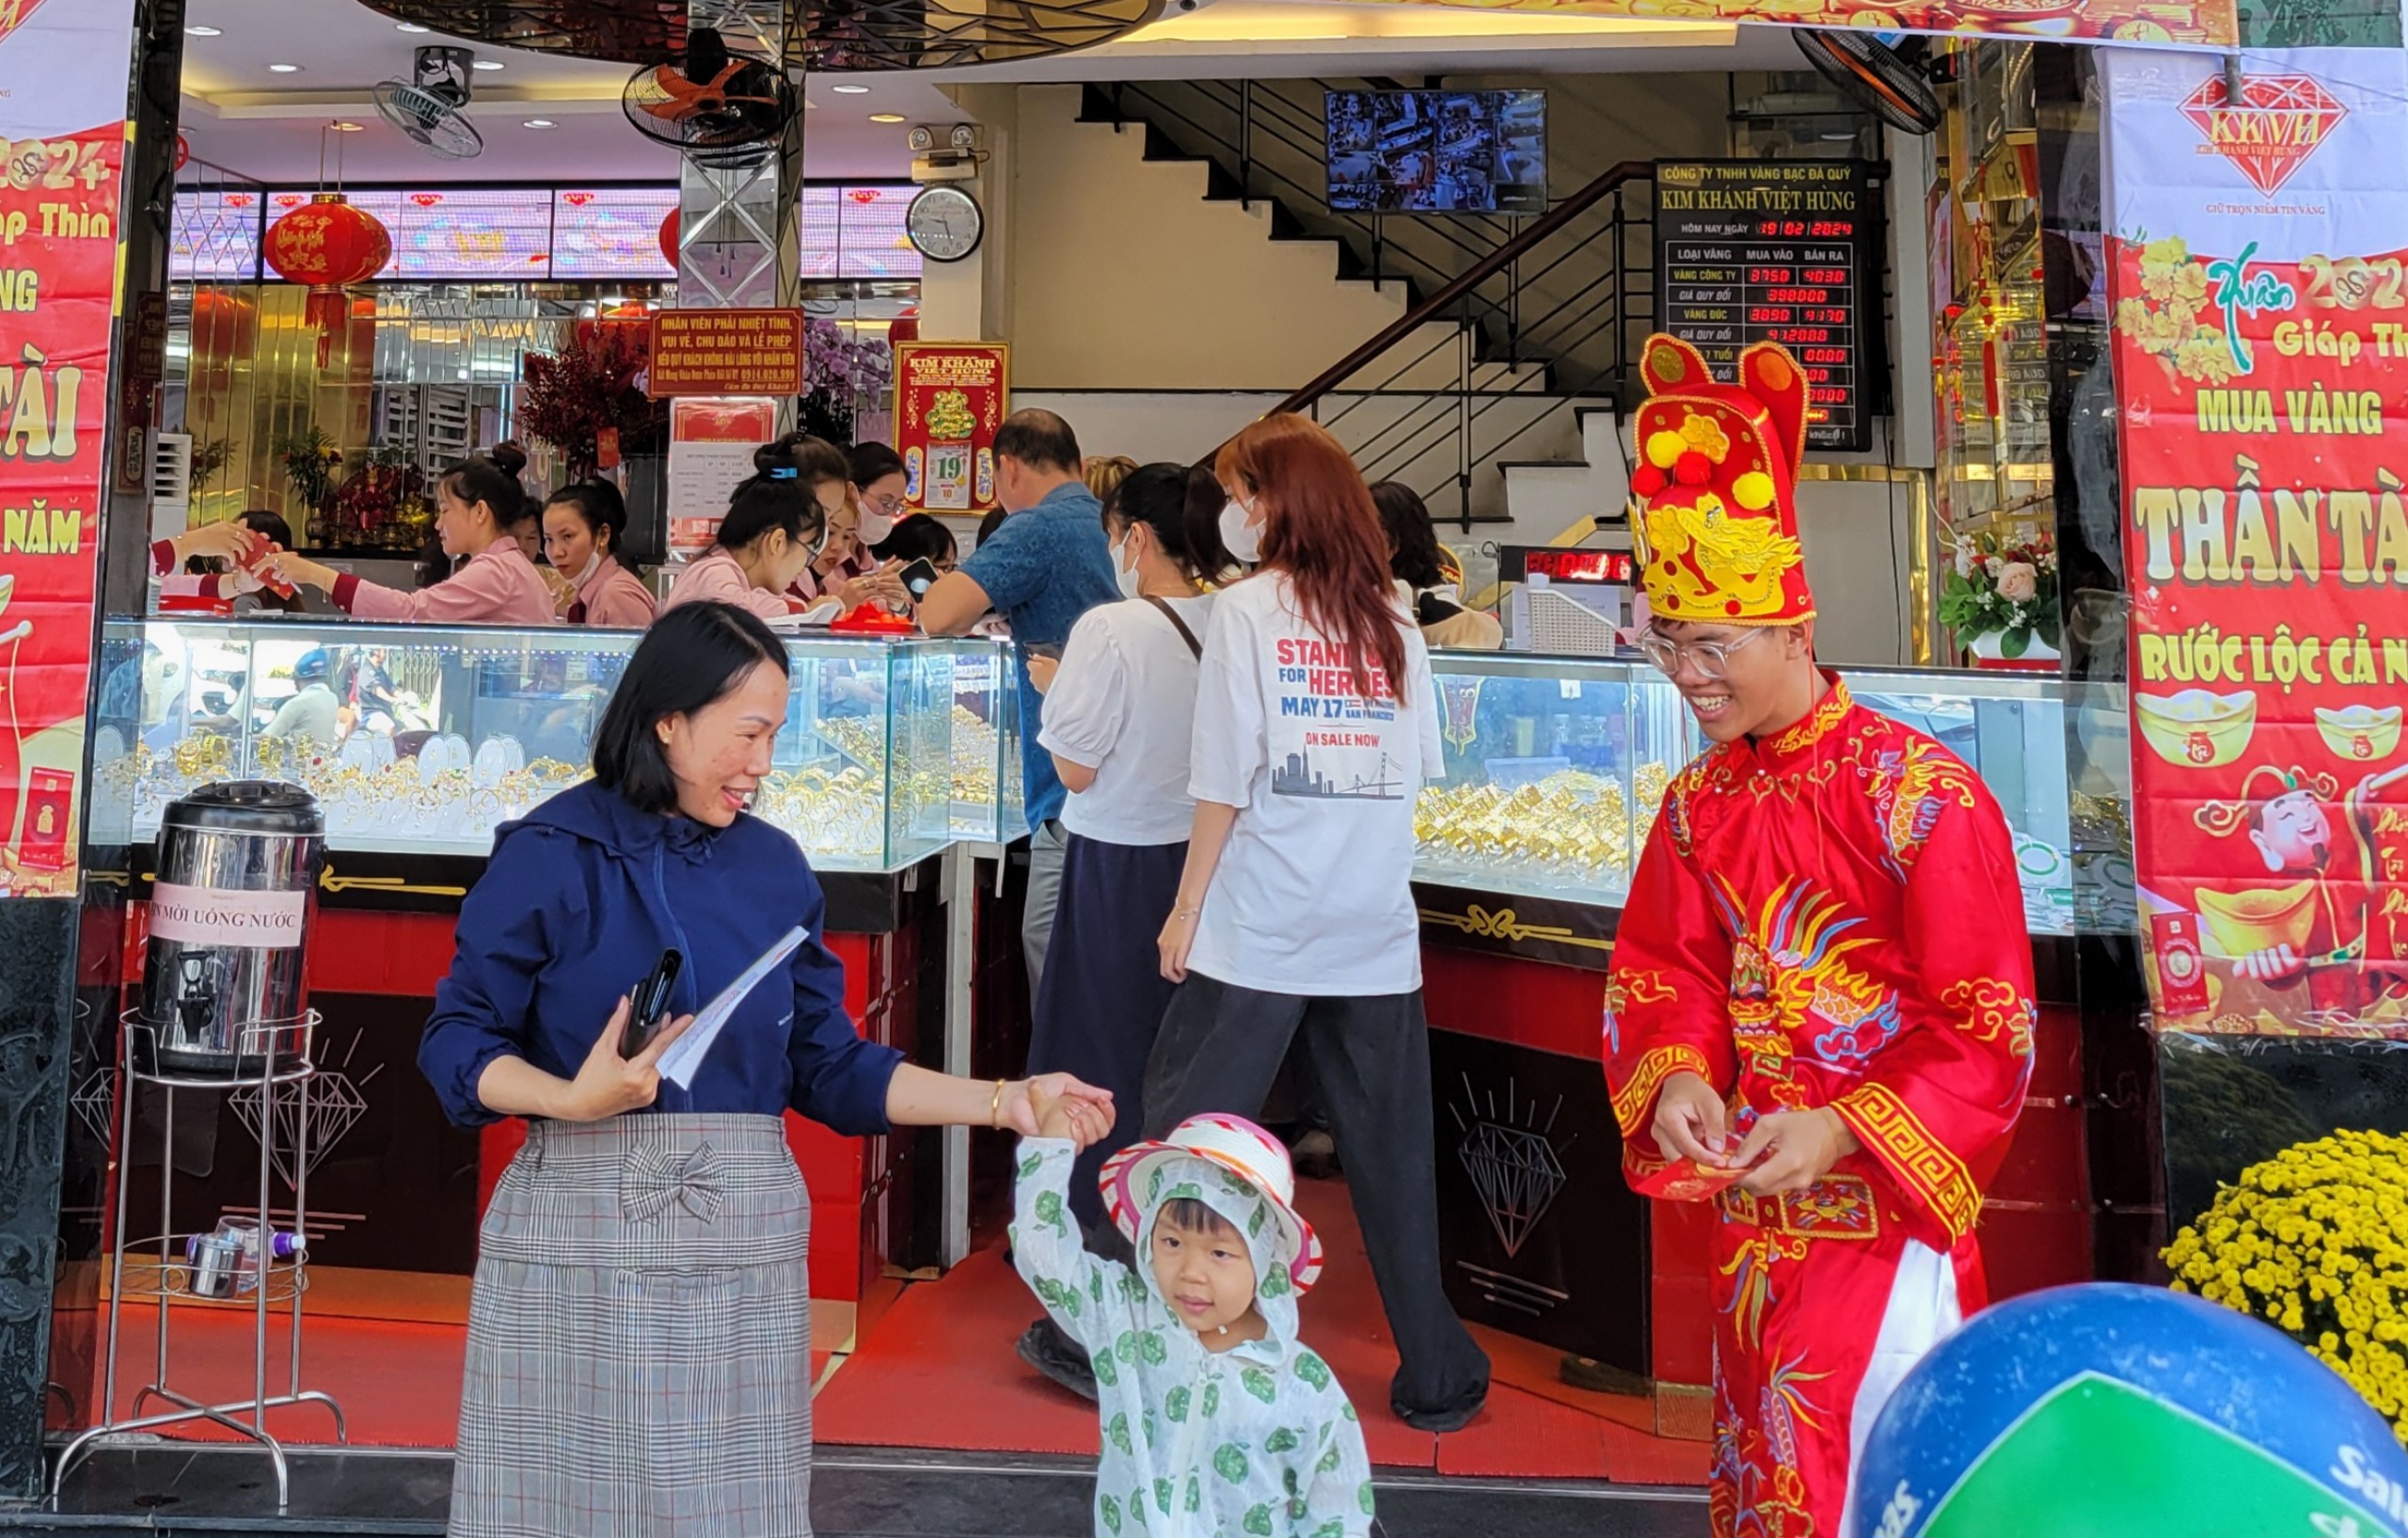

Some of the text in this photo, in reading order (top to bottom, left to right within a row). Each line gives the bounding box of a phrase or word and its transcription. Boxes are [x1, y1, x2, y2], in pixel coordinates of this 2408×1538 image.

[2211, 111, 2322, 146] KKVH
[1665, 166, 1852, 182] CÔNG TY TNHH VÀNG BẠC ĐÁ QUÝ
[1661, 185, 1857, 215] KIM KHÁNH VIỆT HÙNG
[39, 200, 110, 239] Thìn
[1704, 224, 1722, 234] NAY
[1678, 249, 1701, 262] LOẠI
[1703, 247, 1733, 261] VÀNG
[1747, 250, 1770, 261] MUA
[1772, 248, 1794, 261] VÀO
[1829, 250, 1844, 262] RA
[1699, 269, 1723, 280] CÔNG
[1726, 271, 1736, 280] TY
[2299, 253, 2408, 311] 202
[1696, 290, 1714, 301] QUY
[661, 315, 688, 330] NHÂN
[690, 315, 712, 330] VIÊN
[1696, 328, 1714, 340] QUY
[661, 335, 677, 348] VUI
[696, 335, 716, 348] CHU
[2273, 318, 2408, 367] Giáp Th
[910, 358, 939, 368] KIM
[2196, 381, 2384, 435] MUA VÀNG
[937, 457, 962, 480] 19
[4, 497, 83, 555] NĂM
[2134, 452, 2408, 587] THẦN TÀ
[2138, 621, 2244, 684] RƯỚC
[2249, 623, 2323, 695] LỘC
[2328, 623, 2379, 685] CẢ
[1278, 667, 1307, 683] FOR
[1281, 696, 1319, 717] MAY
[1323, 699, 1343, 719] 17
[1306, 732, 1381, 748] ON SALE NOW
[164, 903, 189, 923] MỜI
[249, 911, 296, 929] NƯỚC
